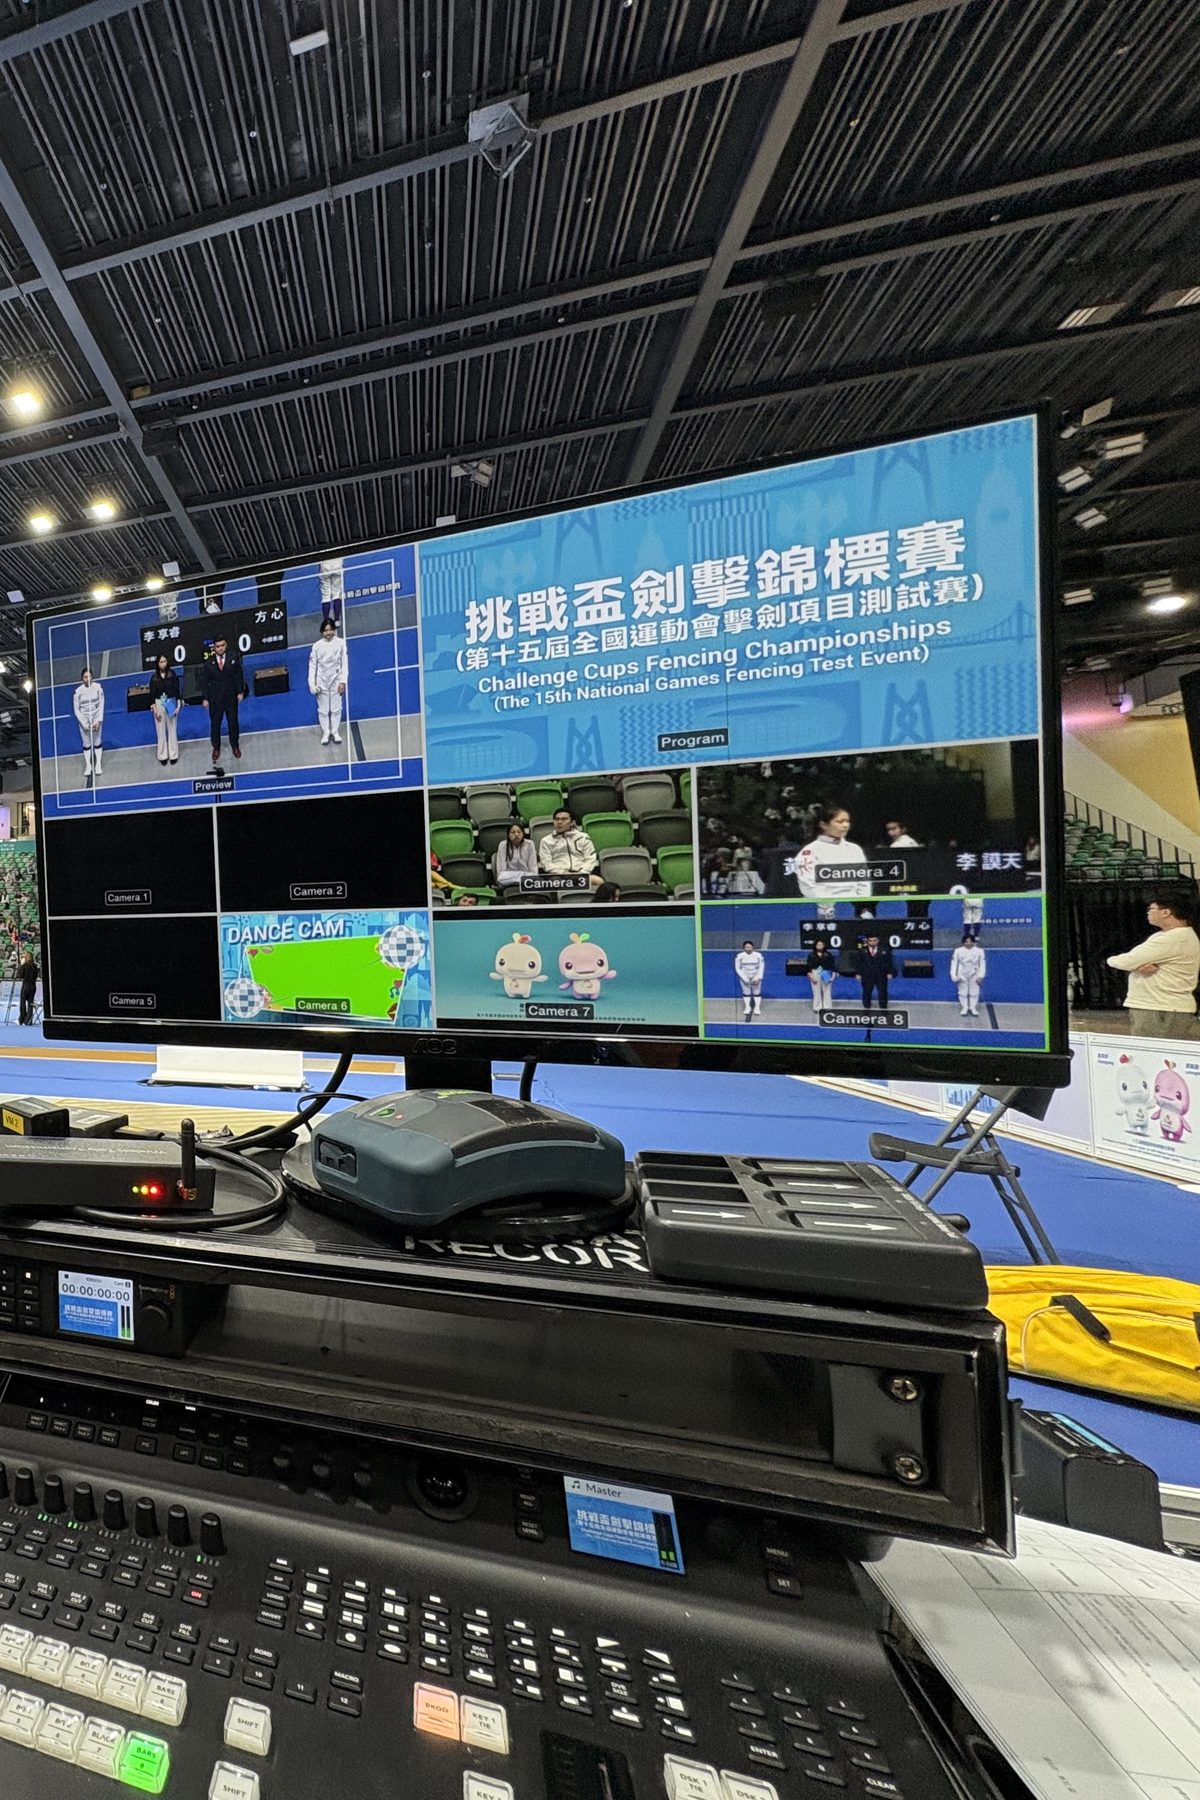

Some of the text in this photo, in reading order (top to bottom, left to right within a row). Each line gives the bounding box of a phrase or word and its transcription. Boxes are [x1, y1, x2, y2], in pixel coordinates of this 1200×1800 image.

[465, 518, 967, 645] 挑戰盃劍擊錦標賽
[456, 573, 984, 673] (第十五屆全國運動會擊劍項目測試賽)
[238, 633, 251, 652] 0
[174, 645, 186, 663] 0
[478, 619, 952, 694] Challenge Cups Fencing Championships
[494, 643, 930, 713] (The 15th National Games Fencing Test Event)
[661, 734, 726, 750] Program
[195, 780, 233, 791] Preview
[956, 853, 977, 871] 李
[819, 865, 900, 879] Camera 4
[523, 877, 587, 889] Camera 3
[293, 885, 344, 896] Camera 2
[107, 893, 148, 902] Camera 1
[228, 919, 346, 945] DANCE CAM
[830, 935, 842, 949] 0
[889, 935, 901, 949] 0
[112, 996, 153, 1006] Camera 5
[298, 1001, 348, 1011] Camera 6
[528, 1006, 578, 1017] Camera
[583, 1007, 592, 1017] 7
[823, 1013, 905, 1025] Camera 8
[62, 1283, 130, 1301] 00:00:00:00
[585, 1483, 622, 1498] Master
[267, 1592, 284, 1601] LOGO
[261, 1611, 281, 1621] INVERT
[114, 1671, 137, 1682] BLACK
[334, 1671, 359, 1683] MACRO
[425, 1702, 450, 1714] BKGD
[237, 1717, 259, 1729] SHIFT
[473, 1712, 489, 1723] KEY
[478, 1719, 492, 1729] TIE
[92, 1731, 115, 1743] BLACK
[136, 1747, 157, 1758] BARS
[750, 1745, 778, 1759] ENTER
[679, 1773, 698, 1785] DSK
[866, 1777, 897, 1791] CLEAR
[223, 1785, 246, 1797] SHIFT
[689, 1784, 704, 1794] TIE
